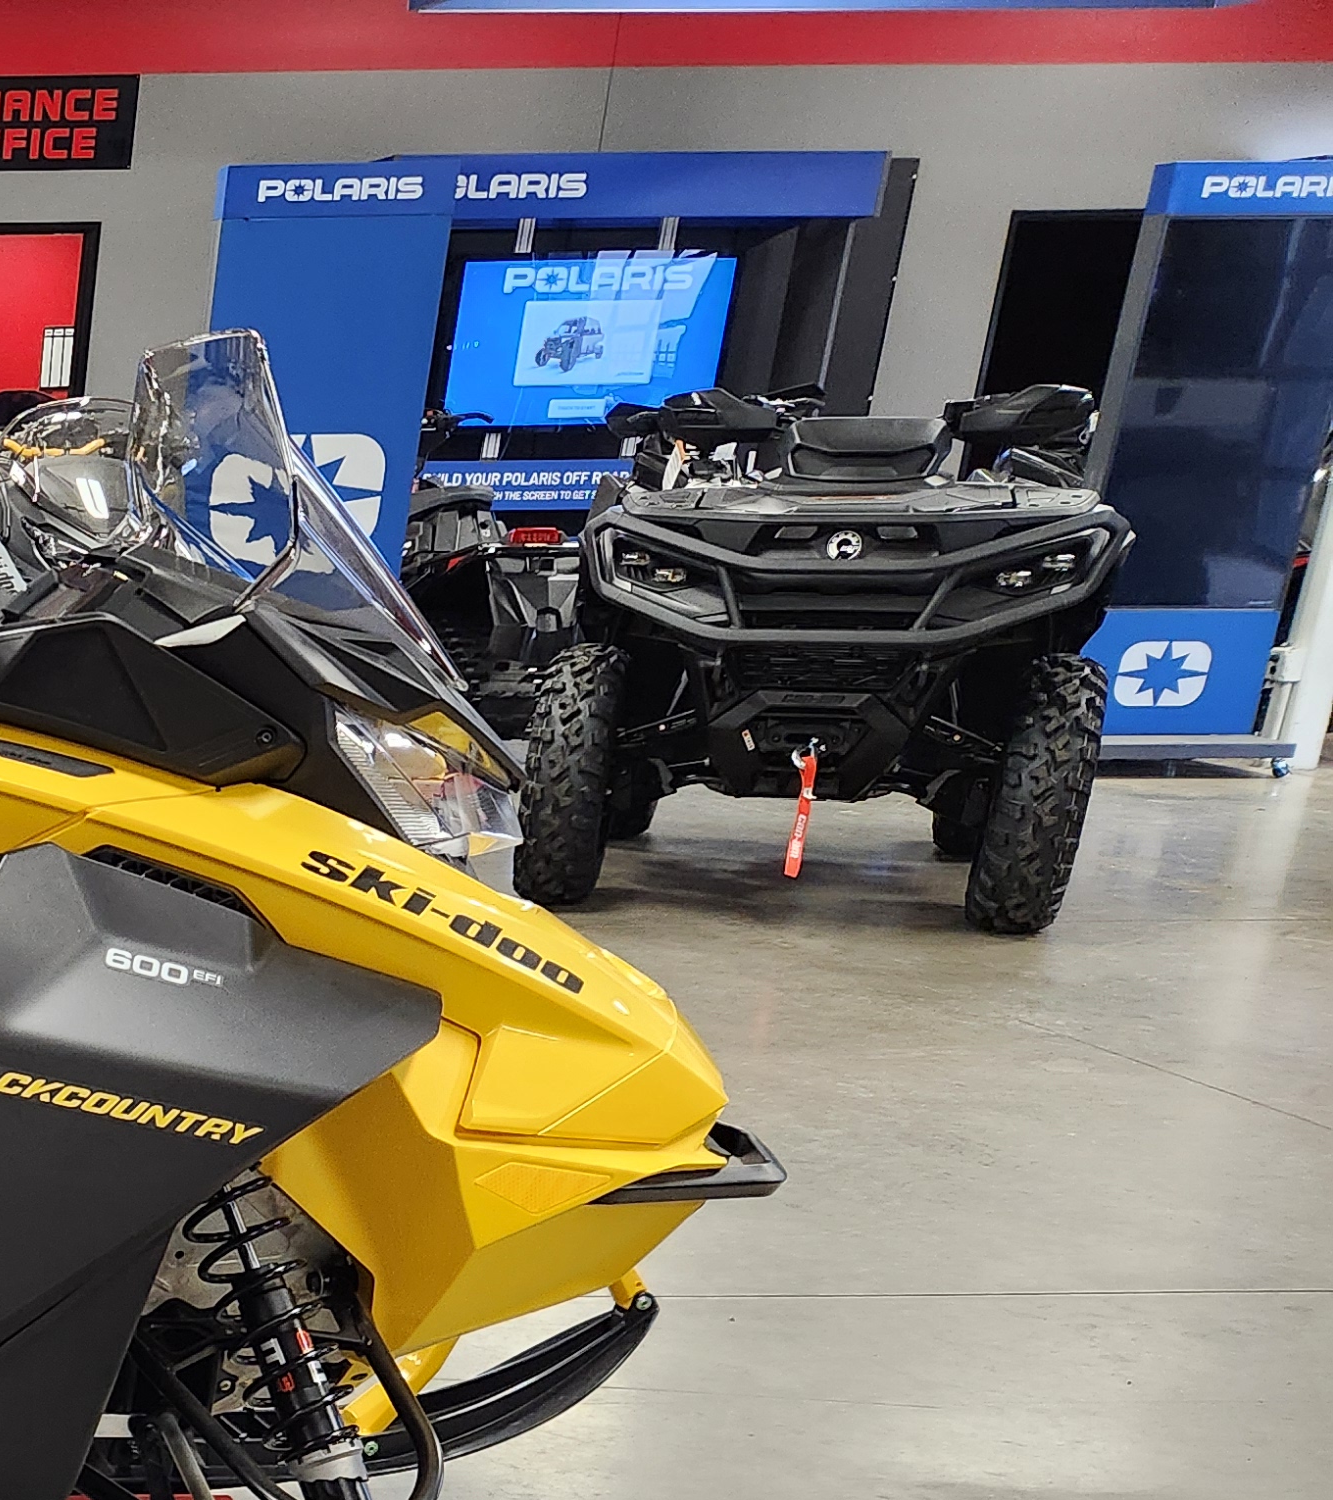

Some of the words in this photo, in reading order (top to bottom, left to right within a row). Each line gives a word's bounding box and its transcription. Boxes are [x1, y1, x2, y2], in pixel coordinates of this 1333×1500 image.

[257, 176, 424, 203] POLARIS
[503, 264, 694, 294] POLARIS
[465, 472, 501, 486] YOUR
[502, 471, 561, 486] POLARIS
[562, 471, 591, 485] OFF
[503, 491, 523, 500] THE
[523, 490, 559, 500] SCREEN
[560, 490, 572, 500] TO
[573, 489, 591, 500] GET
[299, 848, 585, 996] ski-doo
[105, 947, 189, 985] 600
[193, 968, 221, 986] EFI
